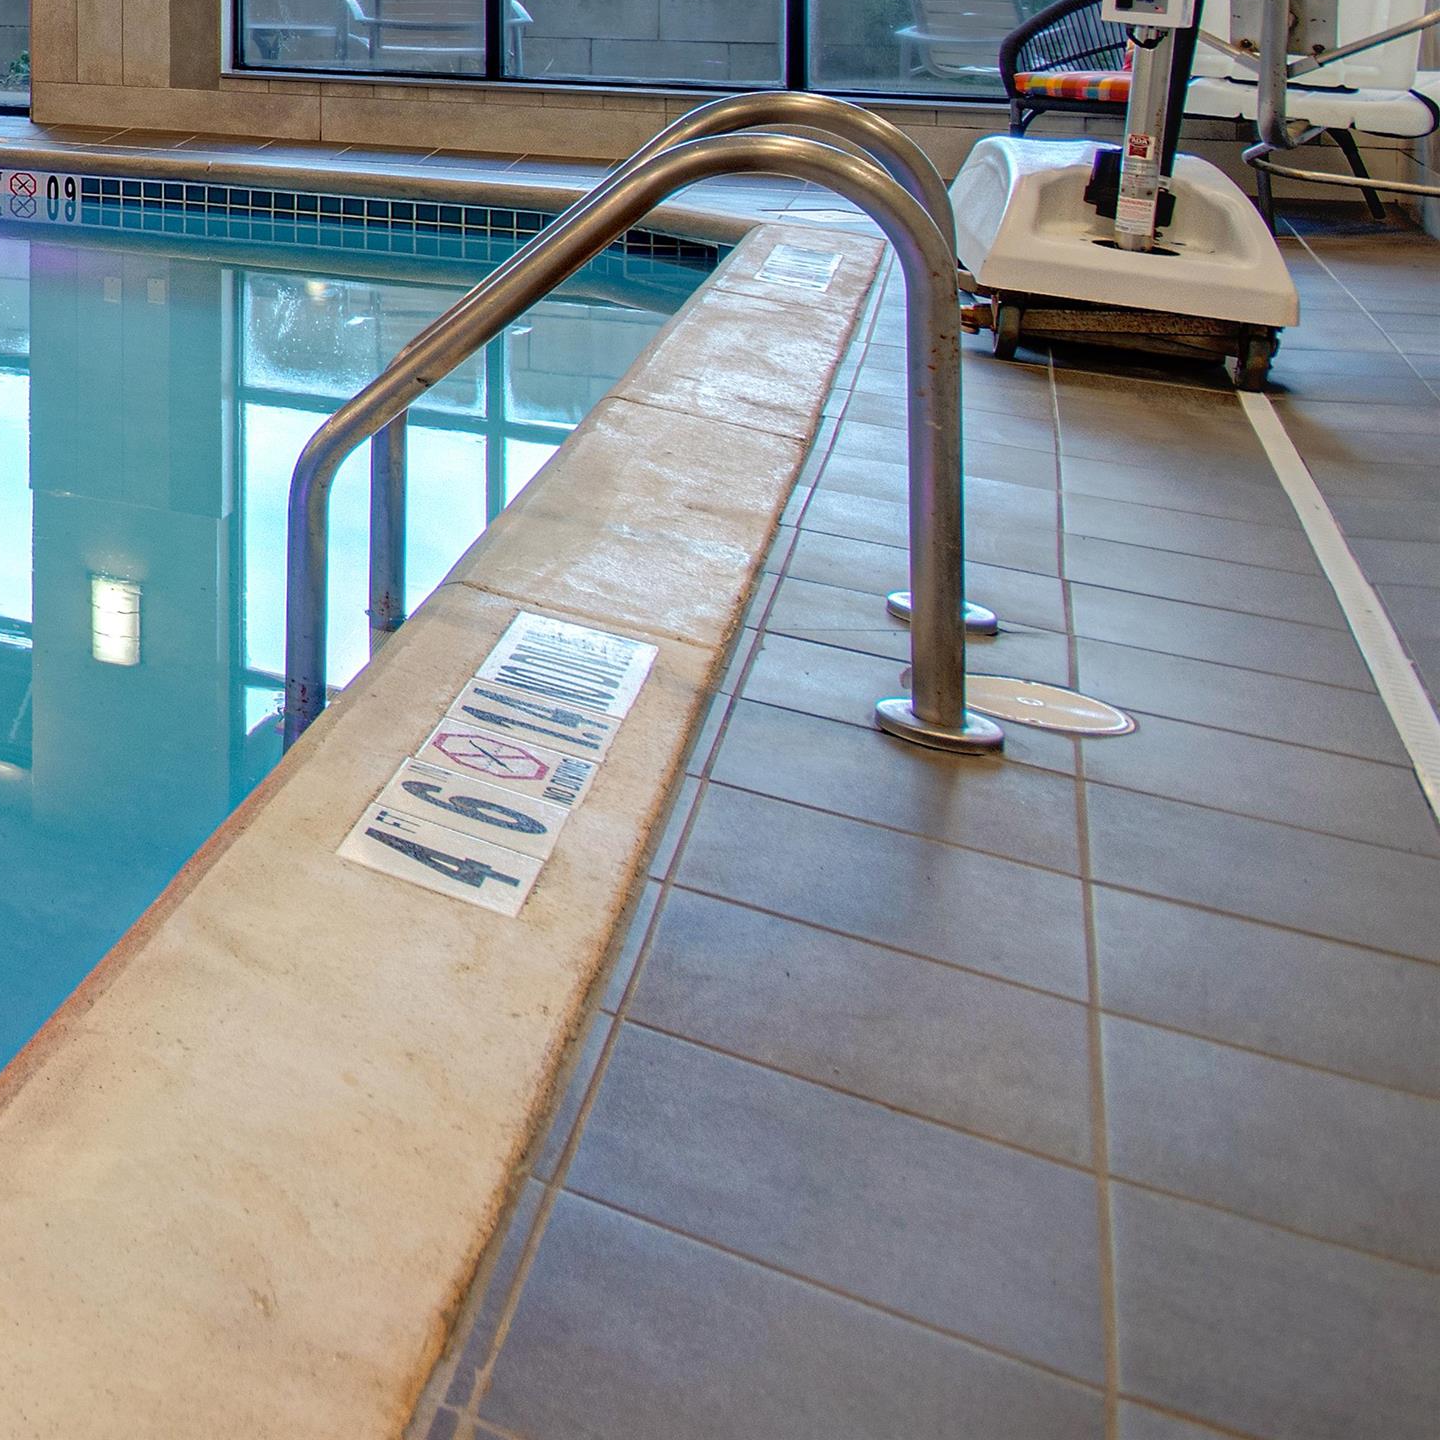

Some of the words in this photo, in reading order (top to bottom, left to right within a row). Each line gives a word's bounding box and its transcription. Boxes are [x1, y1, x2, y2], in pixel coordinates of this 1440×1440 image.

[494, 665, 617, 712] NO
[461, 687, 610, 750] 1.4
[542, 787, 576, 806] NO
[550, 758, 593, 791] DIVING
[375, 810, 421, 834] FT
[401, 780, 548, 835] 6
[364, 827, 521, 888] 4
